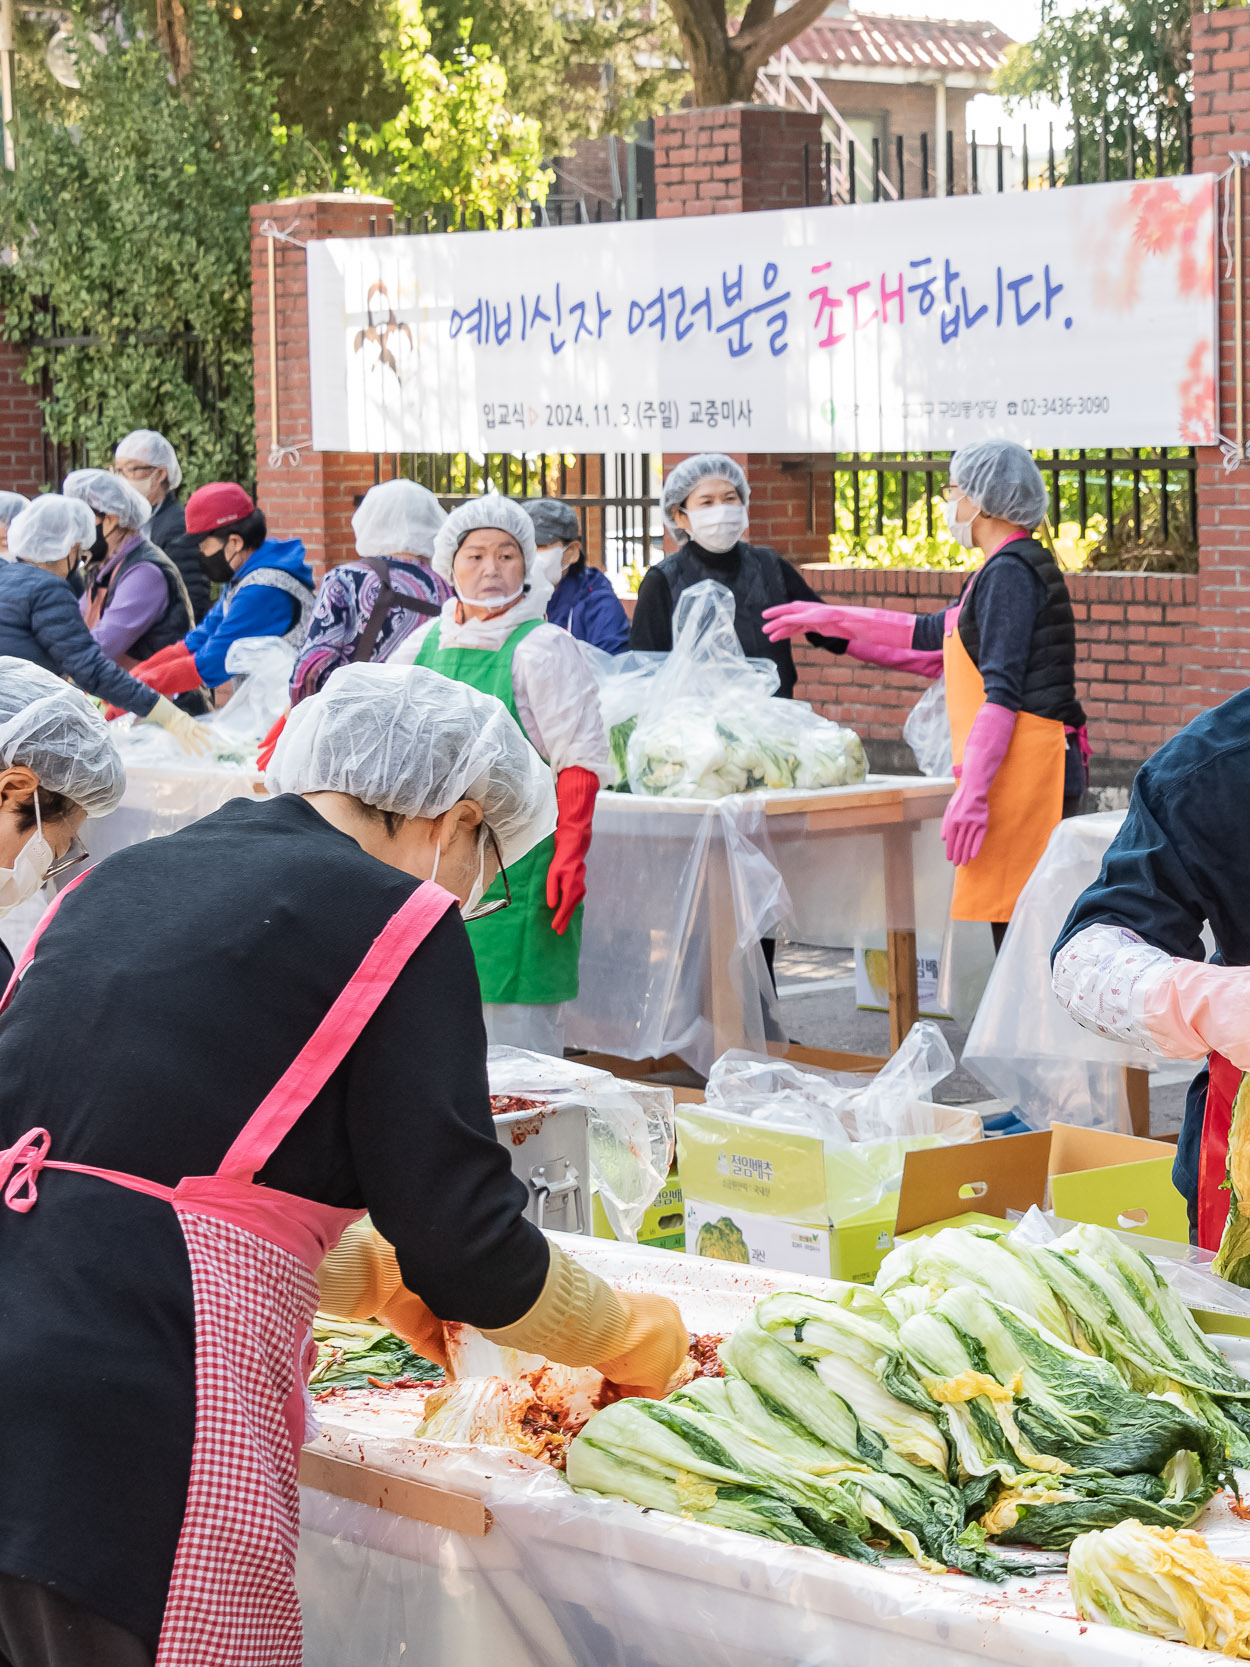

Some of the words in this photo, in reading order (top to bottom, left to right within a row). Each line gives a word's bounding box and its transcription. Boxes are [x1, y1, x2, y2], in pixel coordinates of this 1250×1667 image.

[448, 282, 612, 355] 예비신자
[627, 261, 792, 359] 여러분을
[808, 256, 1075, 349] 초대합니다.
[483, 401, 525, 430] 입교식
[688, 398, 752, 429] 교중미사
[1021, 396, 1111, 416] 02-3436-3090
[731, 1154, 775, 1182] 절임배추
